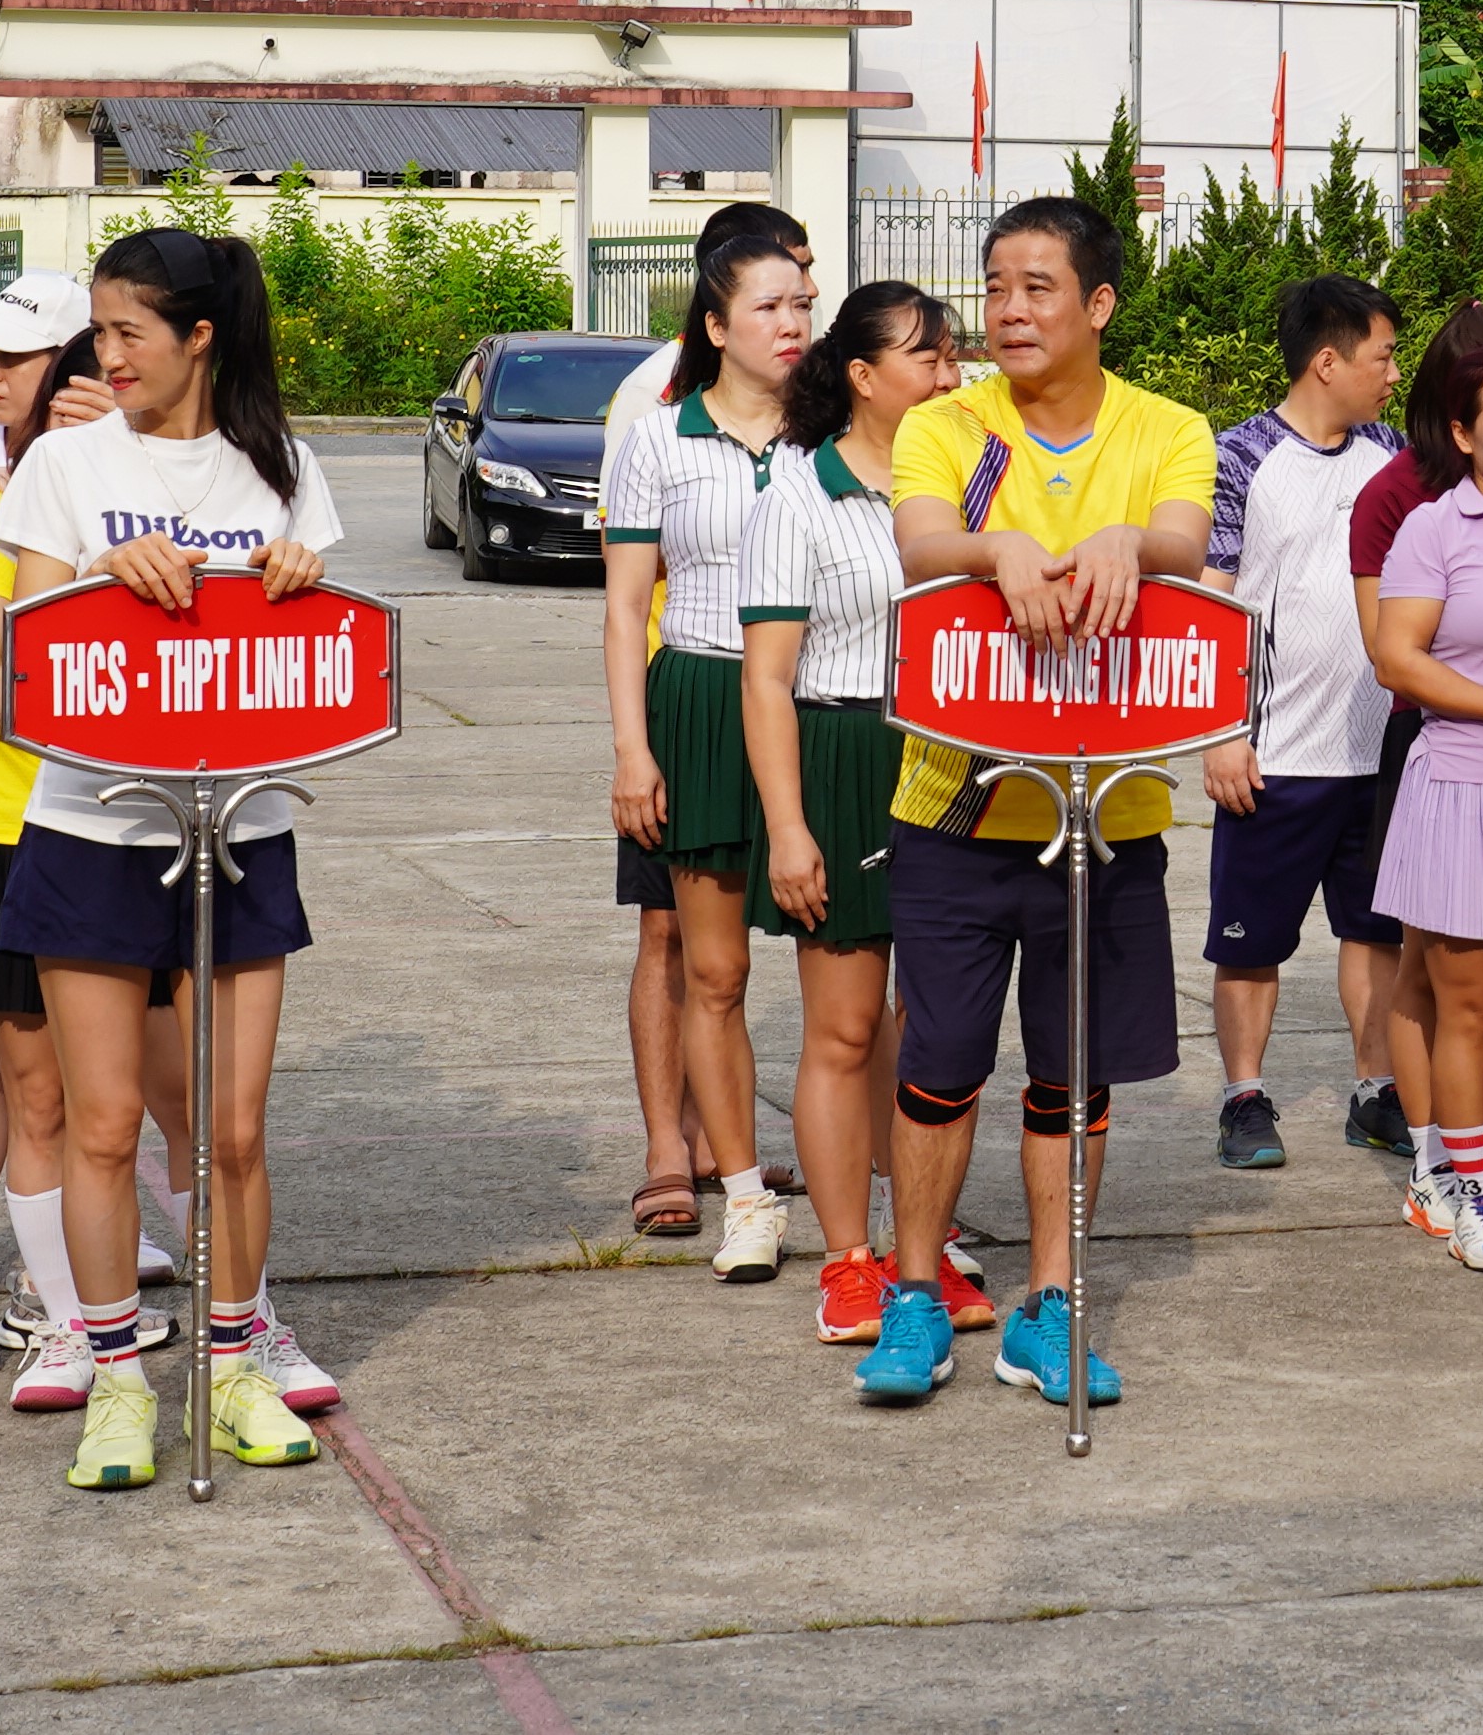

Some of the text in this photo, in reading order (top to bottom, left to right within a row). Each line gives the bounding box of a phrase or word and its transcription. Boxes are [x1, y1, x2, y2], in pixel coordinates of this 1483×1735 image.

[101, 510, 265, 550] Wilson
[48, 640, 128, 717] THCS
[156, 637, 231, 713] THPT
[238, 636, 306, 711] LINH
[314, 609, 356, 709] HỒ
[931, 616, 982, 709] QŨY
[987, 616, 1027, 702] TÍN
[1108, 635, 1131, 719] VỊ
[1135, 624, 1218, 709] XUYÊN
